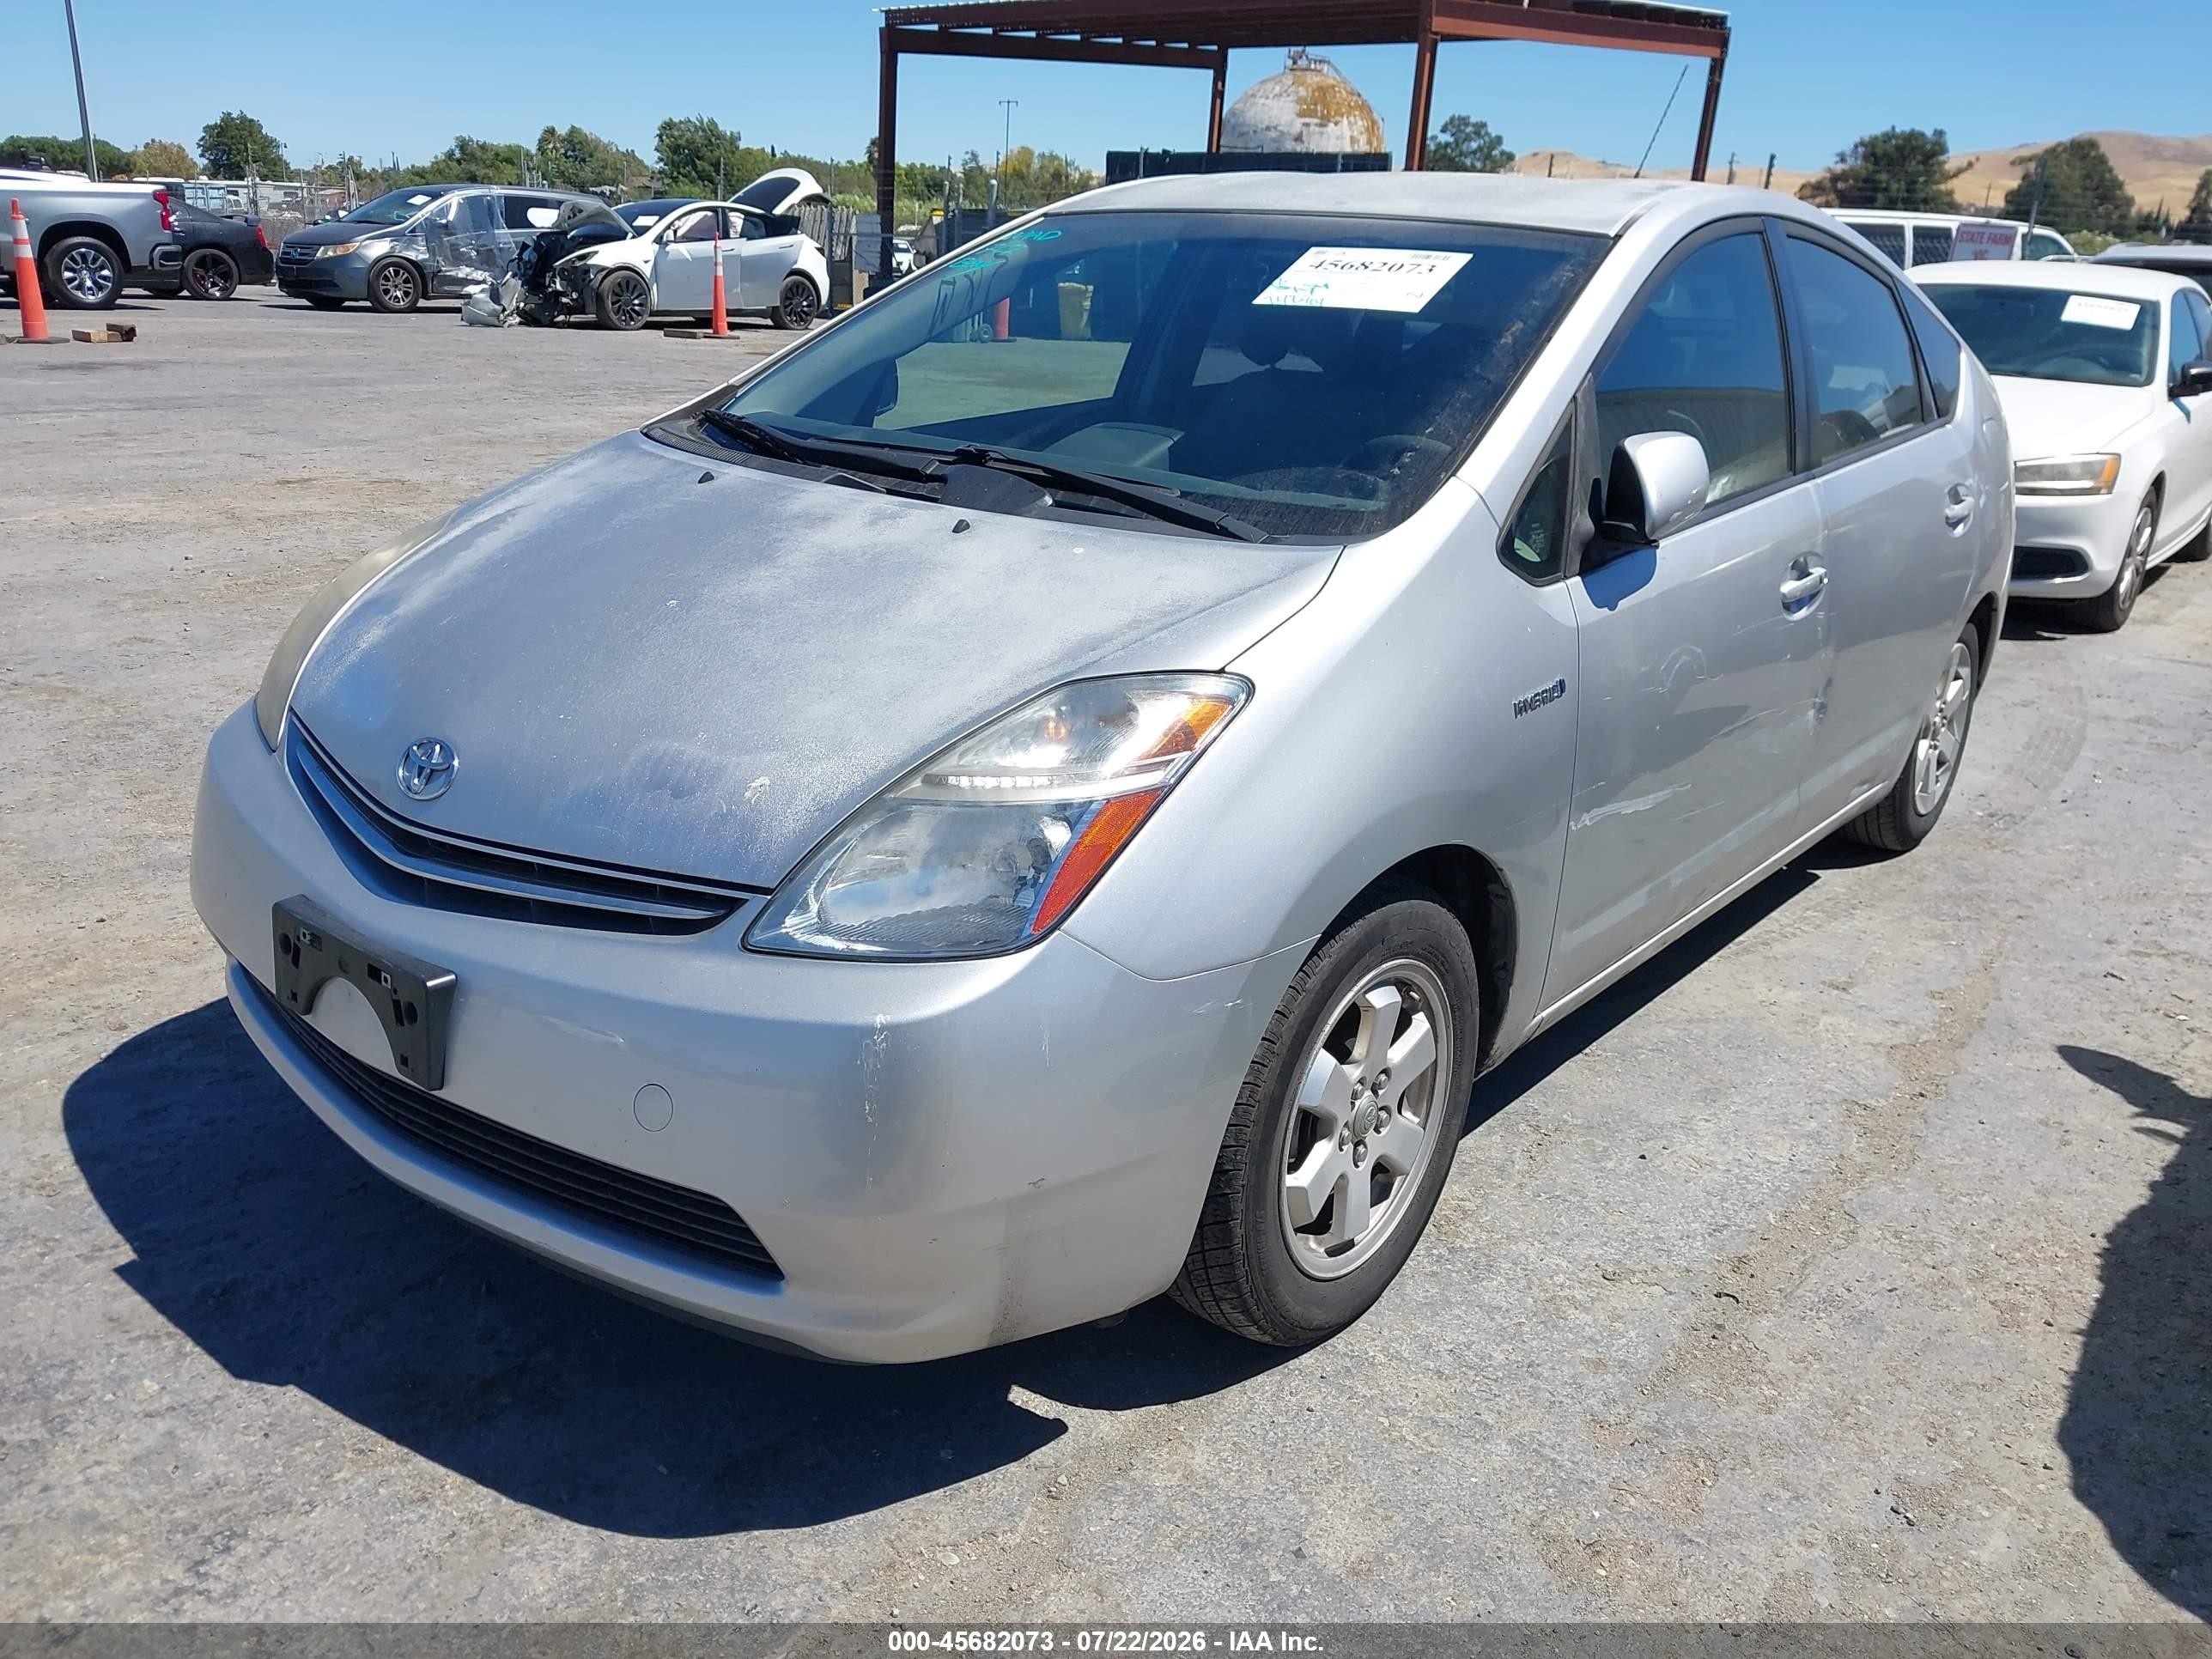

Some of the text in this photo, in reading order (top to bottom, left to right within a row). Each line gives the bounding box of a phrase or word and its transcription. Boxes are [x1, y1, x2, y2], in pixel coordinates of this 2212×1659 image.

[1958, 231, 2013, 246] STATE FARM
[1310, 259, 1437, 275] 45682073
